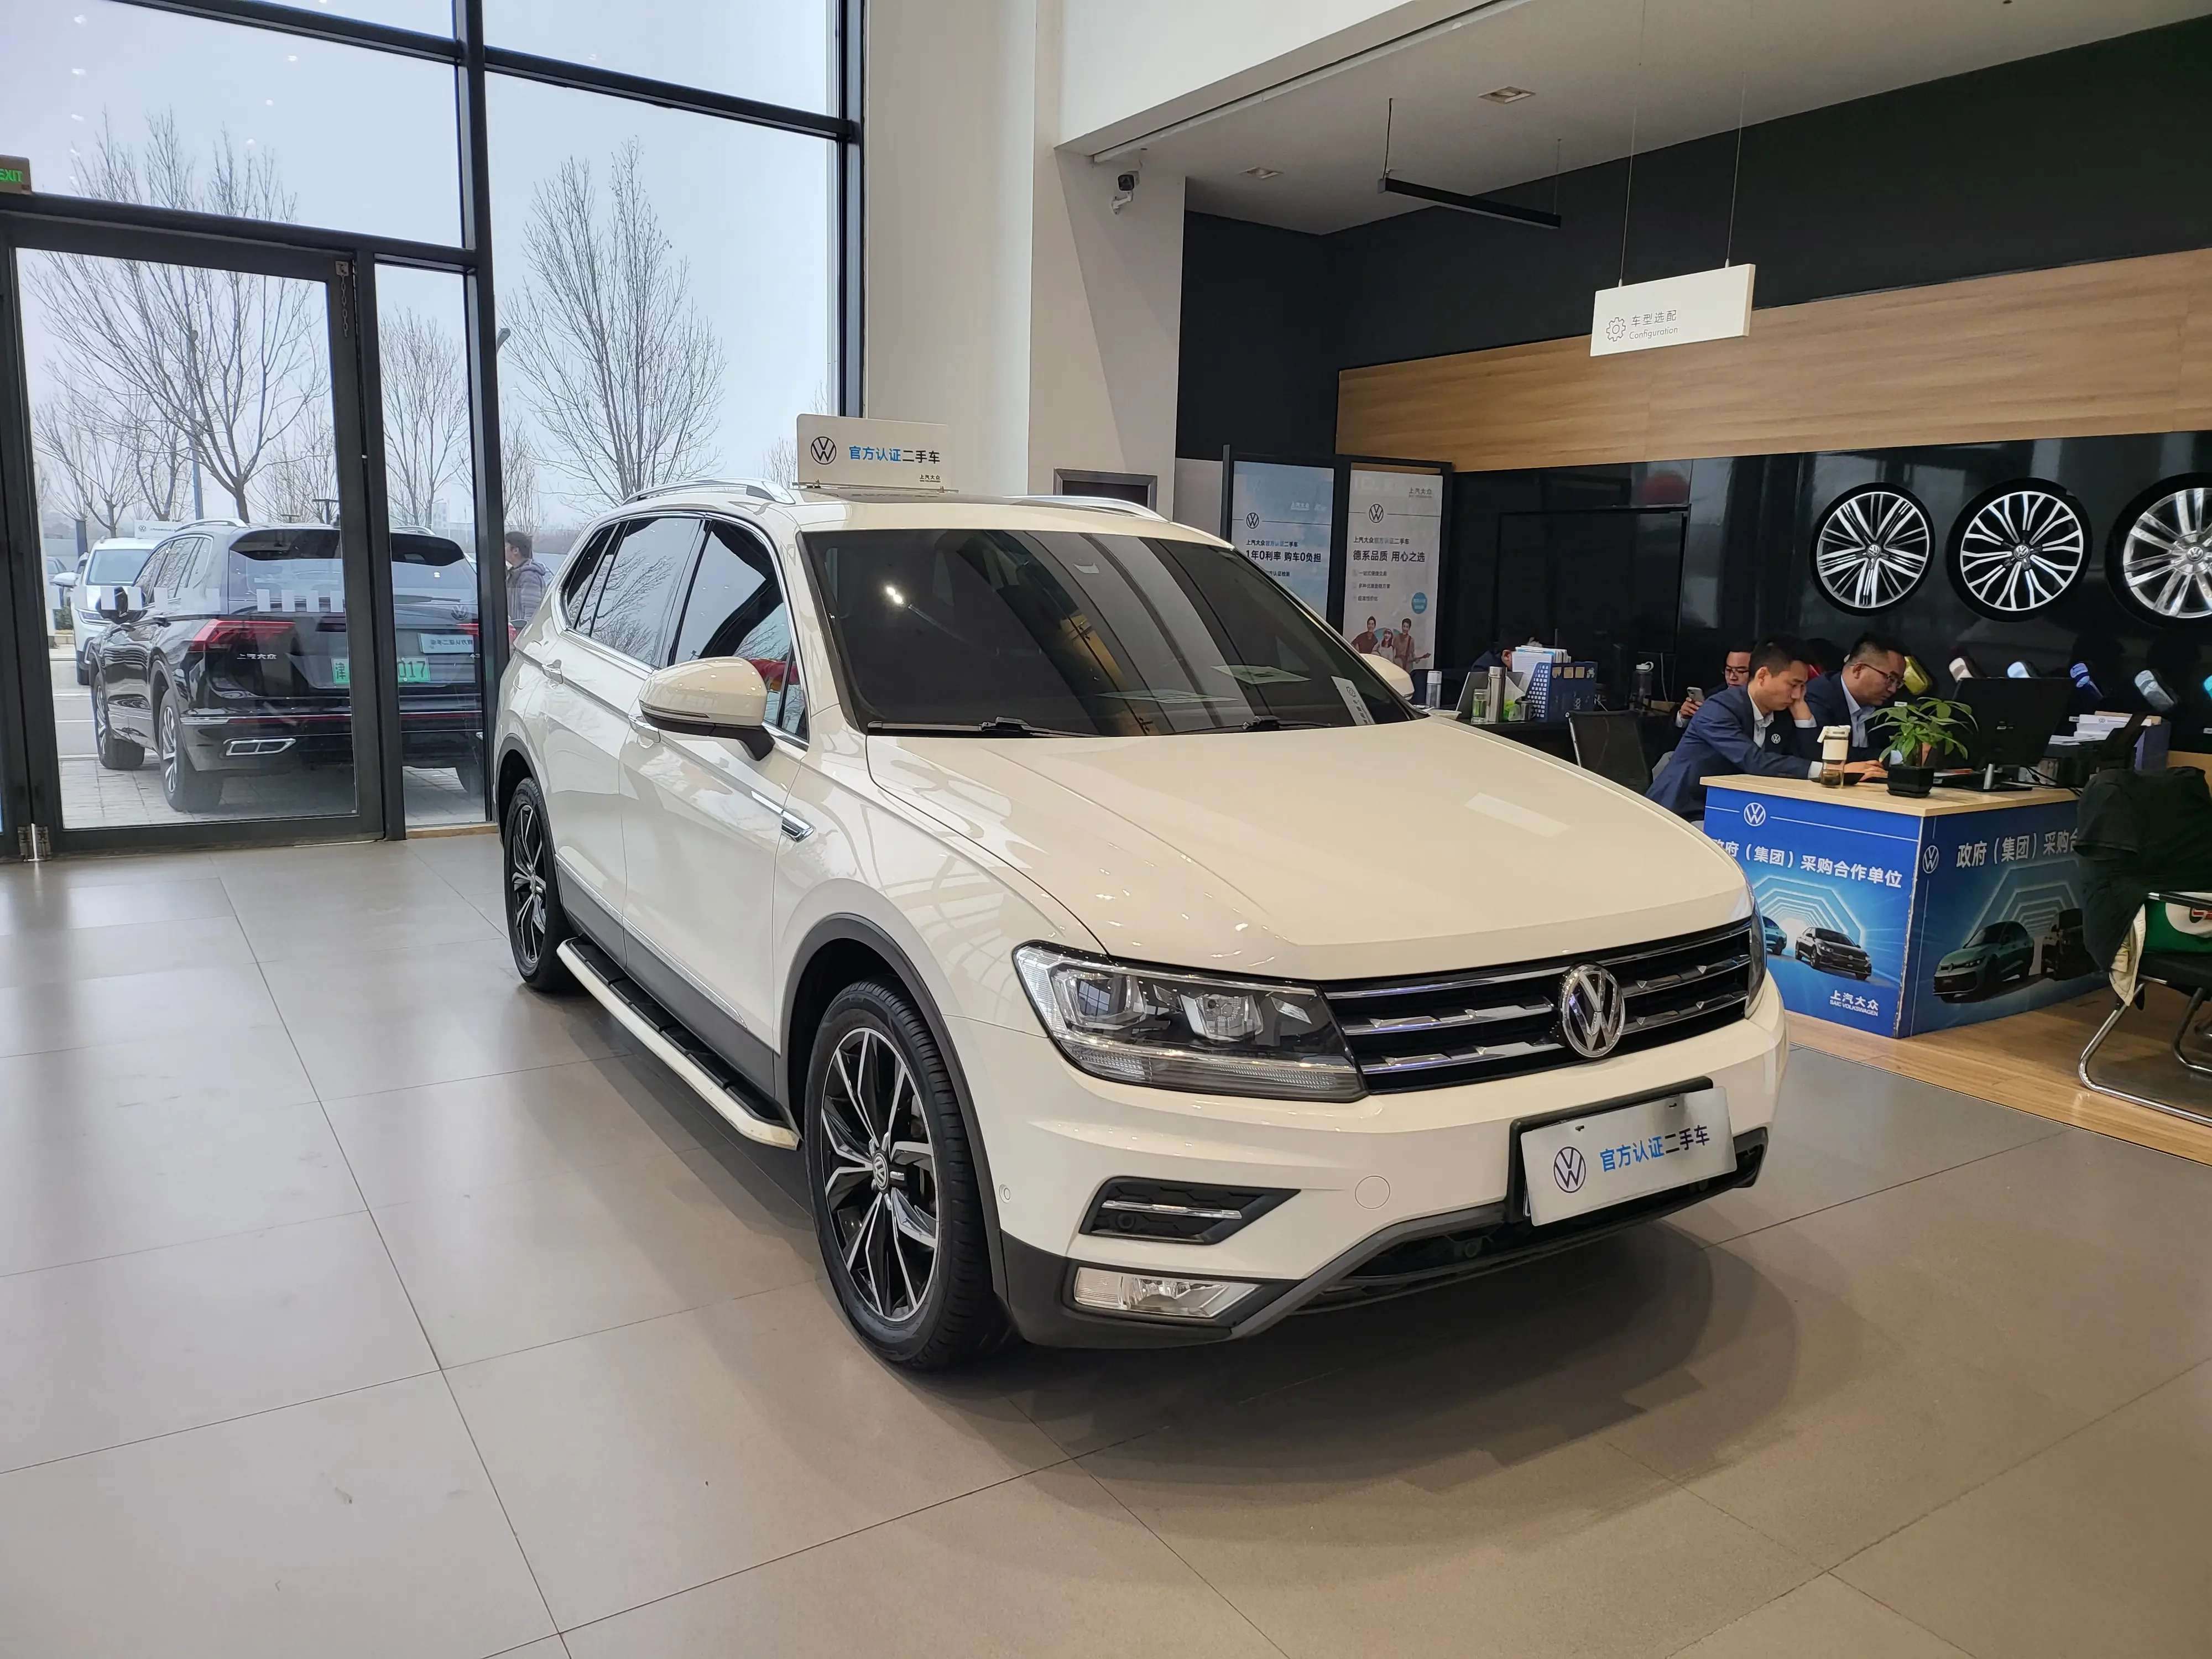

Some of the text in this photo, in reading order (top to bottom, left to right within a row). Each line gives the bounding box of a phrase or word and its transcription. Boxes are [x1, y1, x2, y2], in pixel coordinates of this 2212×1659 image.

[1631, 310, 1677, 327] 车型选配
[1629, 326, 1678, 340] Configuration
[849, 445, 941, 465] 官方认证二手车
[1246, 539, 1298, 547] 上汽大众官方认证二手车
[1246, 550, 1321, 563] 1年0利率 购车0负担
[1353, 550, 1426, 562] 德系品质 用心之选
[1830, 989, 1879, 1010] 上汽大众
[1842, 1003, 1879, 1016] VOLKSWAGEN
[1600, 1124, 1710, 1172] 官方认证二手车
